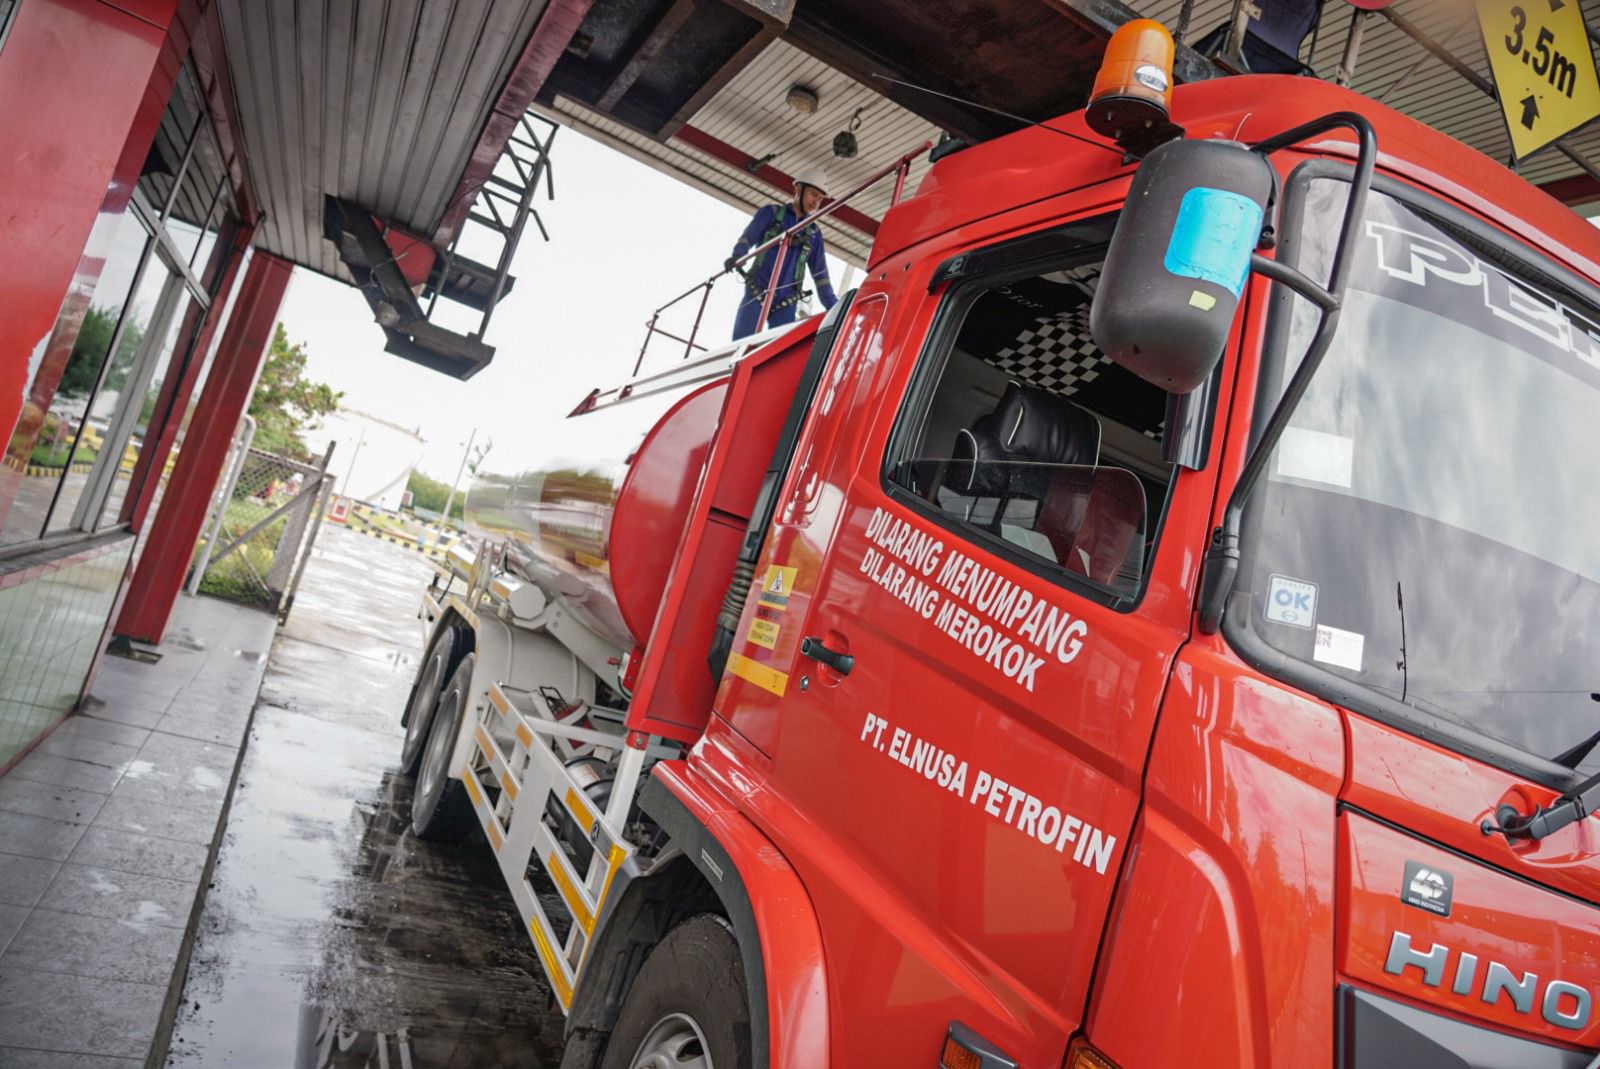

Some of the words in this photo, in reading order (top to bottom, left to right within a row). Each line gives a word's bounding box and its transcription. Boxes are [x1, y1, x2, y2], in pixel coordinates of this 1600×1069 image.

[1505, 6, 1576, 99] 3.5m
[859, 547, 939, 619] DILARANG
[934, 599, 1045, 693] MEROKOK
[865, 506, 944, 576] DILARANG
[936, 550, 1087, 664] MENUMPANG
[1275, 588, 1311, 612] OK
[860, 712, 888, 752] PT.
[888, 727, 968, 798] ELNUSA
[969, 770, 1117, 876] PETROFIN
[1384, 930, 1592, 1030] HINO
